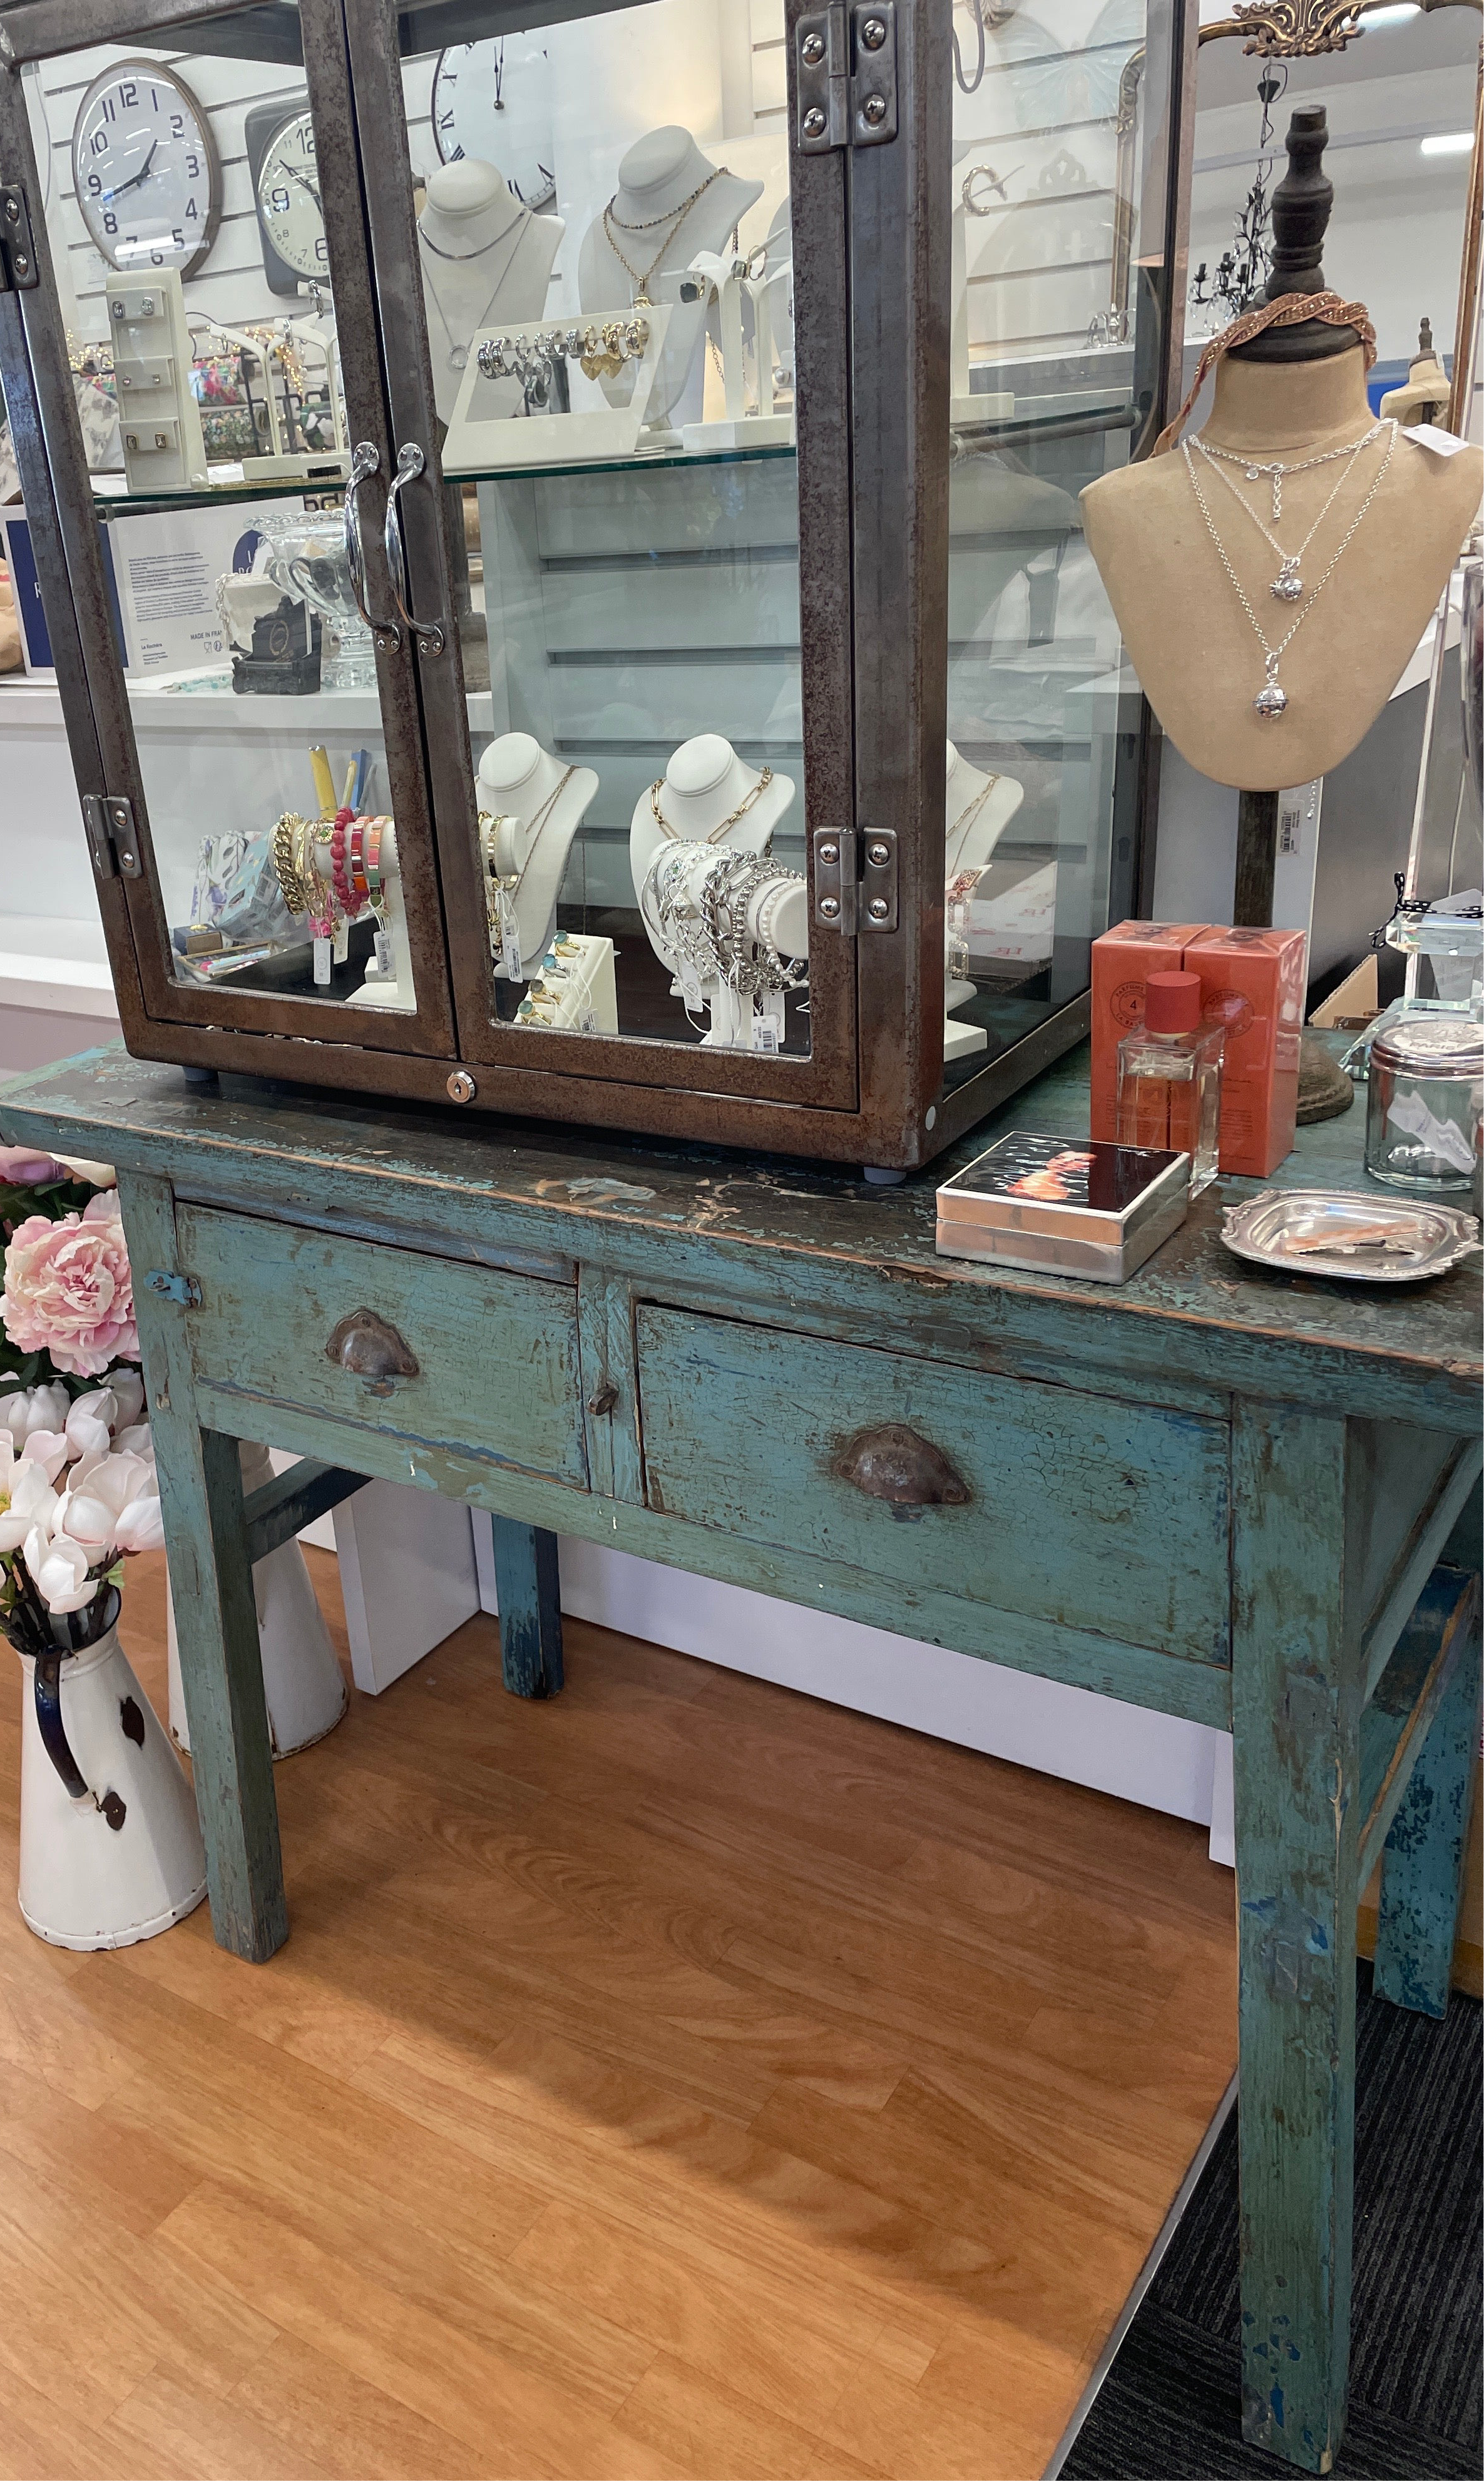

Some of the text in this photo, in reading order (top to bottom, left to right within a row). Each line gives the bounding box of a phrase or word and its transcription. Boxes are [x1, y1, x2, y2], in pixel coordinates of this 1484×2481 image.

[119, 83, 138, 108] 12
[151, 89, 158, 111] 1
[102, 99, 116, 122] 11
[170, 115, 185, 138] 2
[89, 131, 108, 155] 10
[284, 140, 292, 149] 11
[186, 155, 199, 178] 3
[88, 174, 103, 197] 9
[185, 198, 198, 220] 4
[272, 188, 289, 212] 9
[103, 212, 118, 234] 8
[282, 229, 289, 238] 8
[171, 228, 185, 251] 5
[150, 248, 163, 265] 6
[301, 249, 307, 258] 7
[1129, 1000, 1137, 1010] 4
